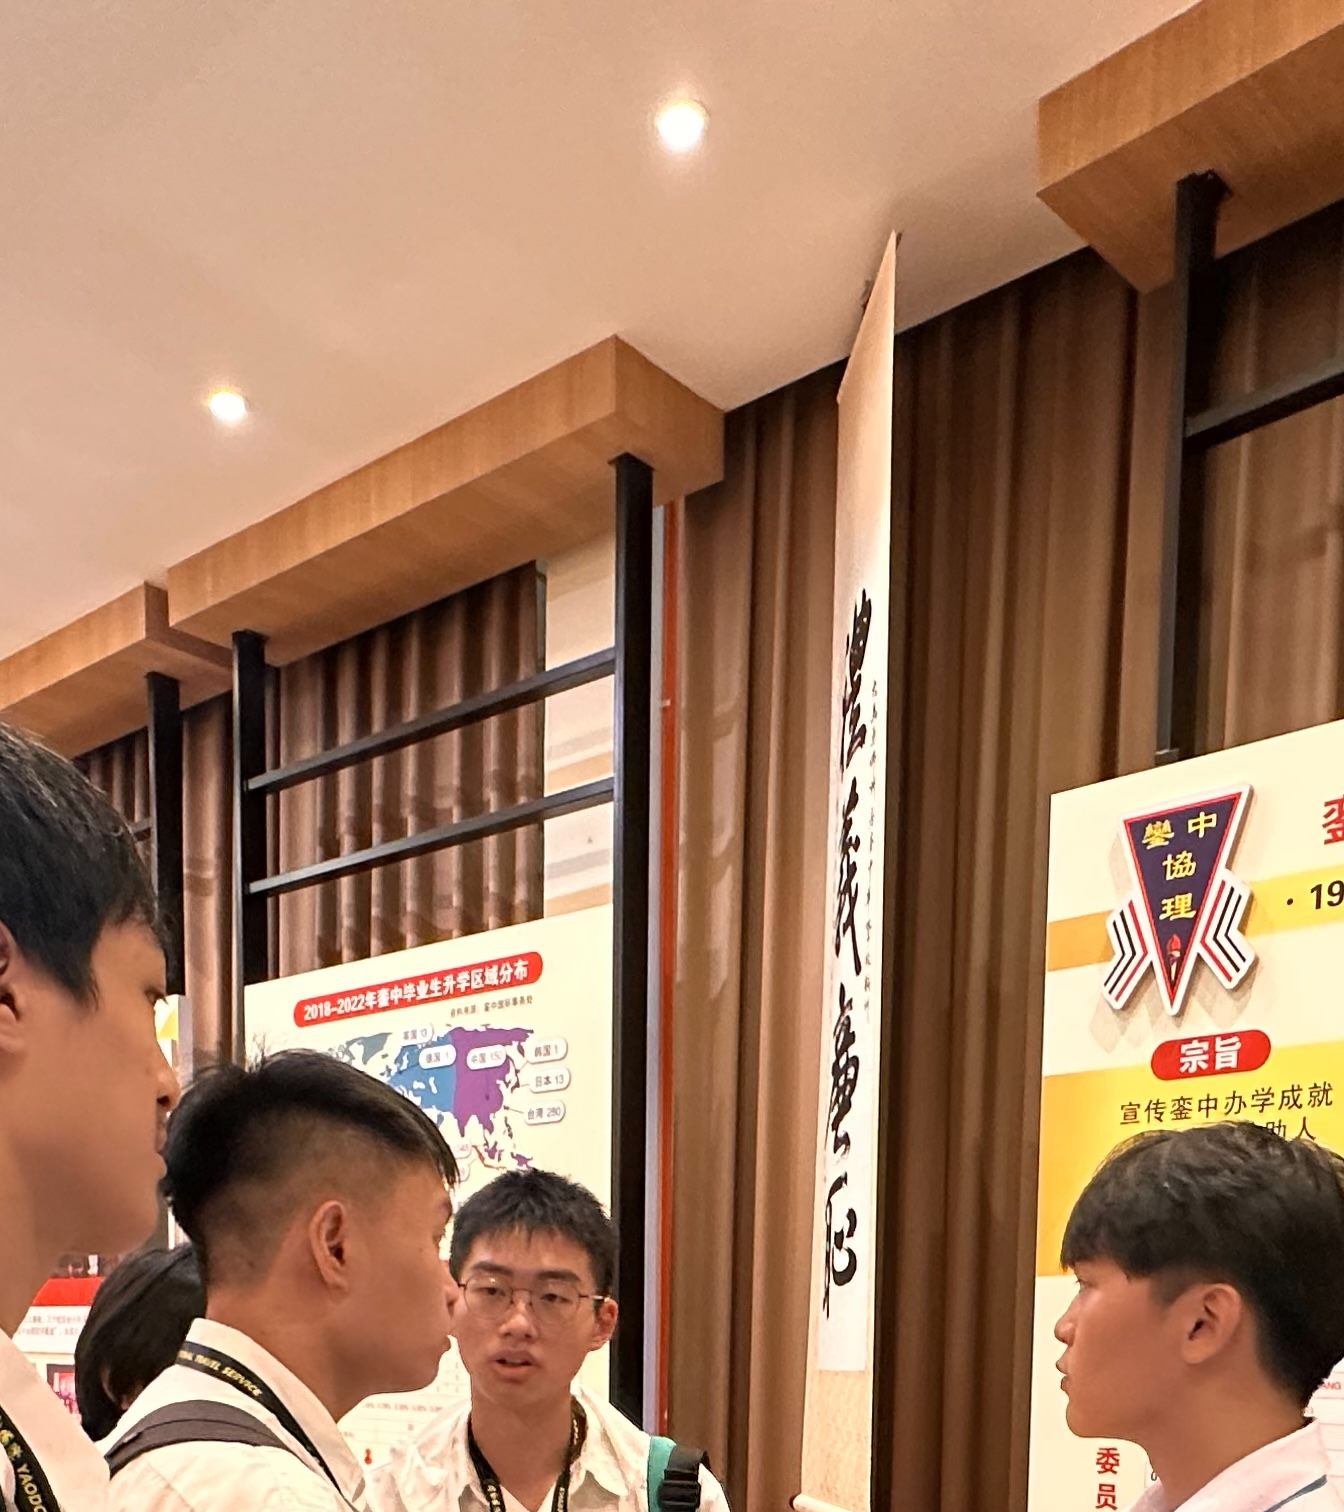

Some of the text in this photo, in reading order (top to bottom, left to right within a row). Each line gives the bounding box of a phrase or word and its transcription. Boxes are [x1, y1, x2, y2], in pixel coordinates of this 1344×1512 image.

[1180, 1037, 1242, 1074] 宗旨
[1120, 1081, 1333, 1124] 宣传銮中办学成就
